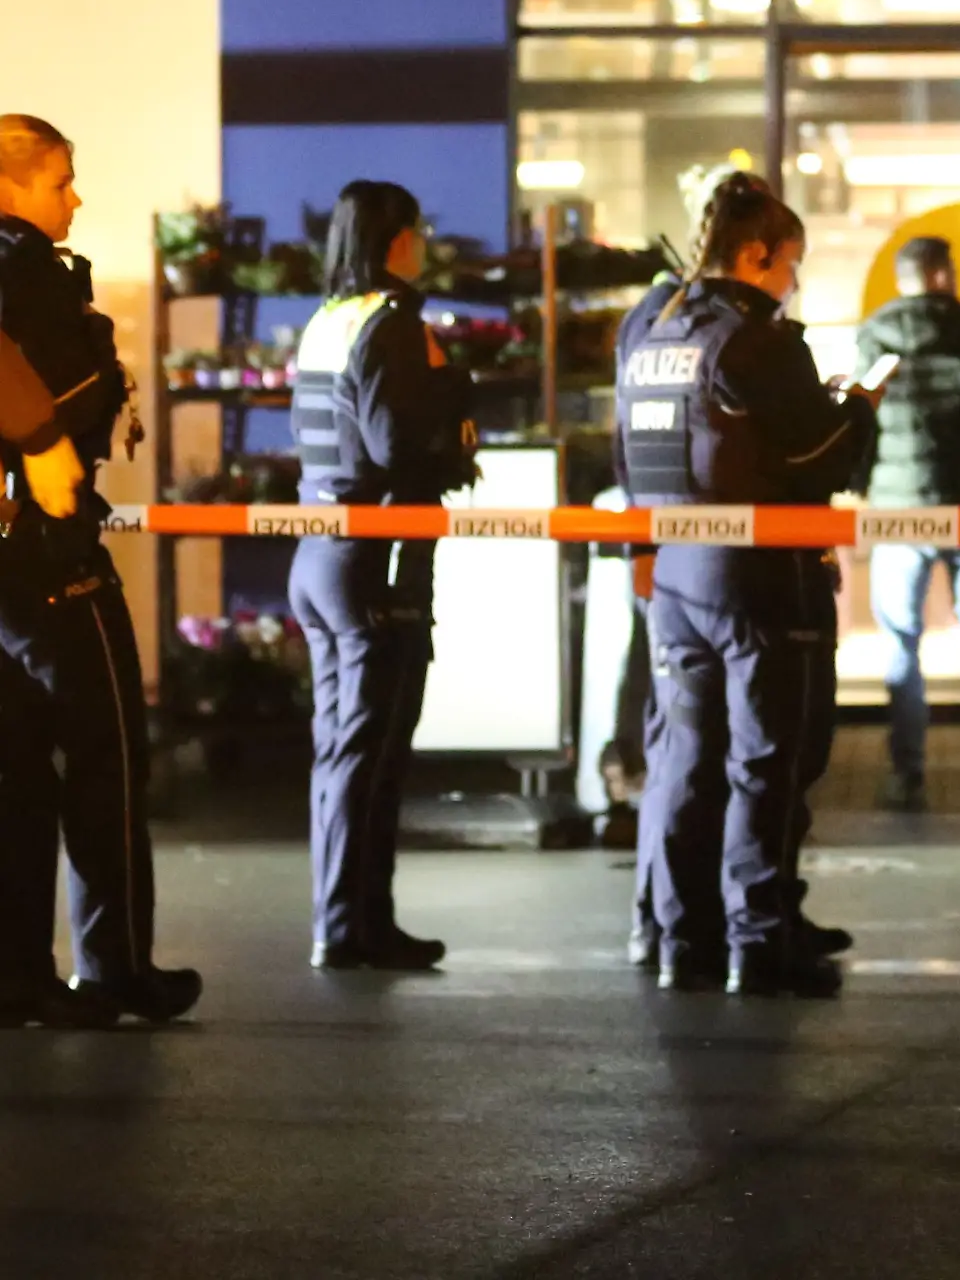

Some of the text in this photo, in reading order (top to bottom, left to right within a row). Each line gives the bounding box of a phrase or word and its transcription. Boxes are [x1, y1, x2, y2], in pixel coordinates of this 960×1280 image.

[625, 347, 703, 385] POLIZEI
[253, 517, 341, 536] POLIZEI
[454, 517, 542, 536] POLIZEI
[657, 518, 746, 536] POLIZEI
[861, 517, 951, 536] POLIZEI
